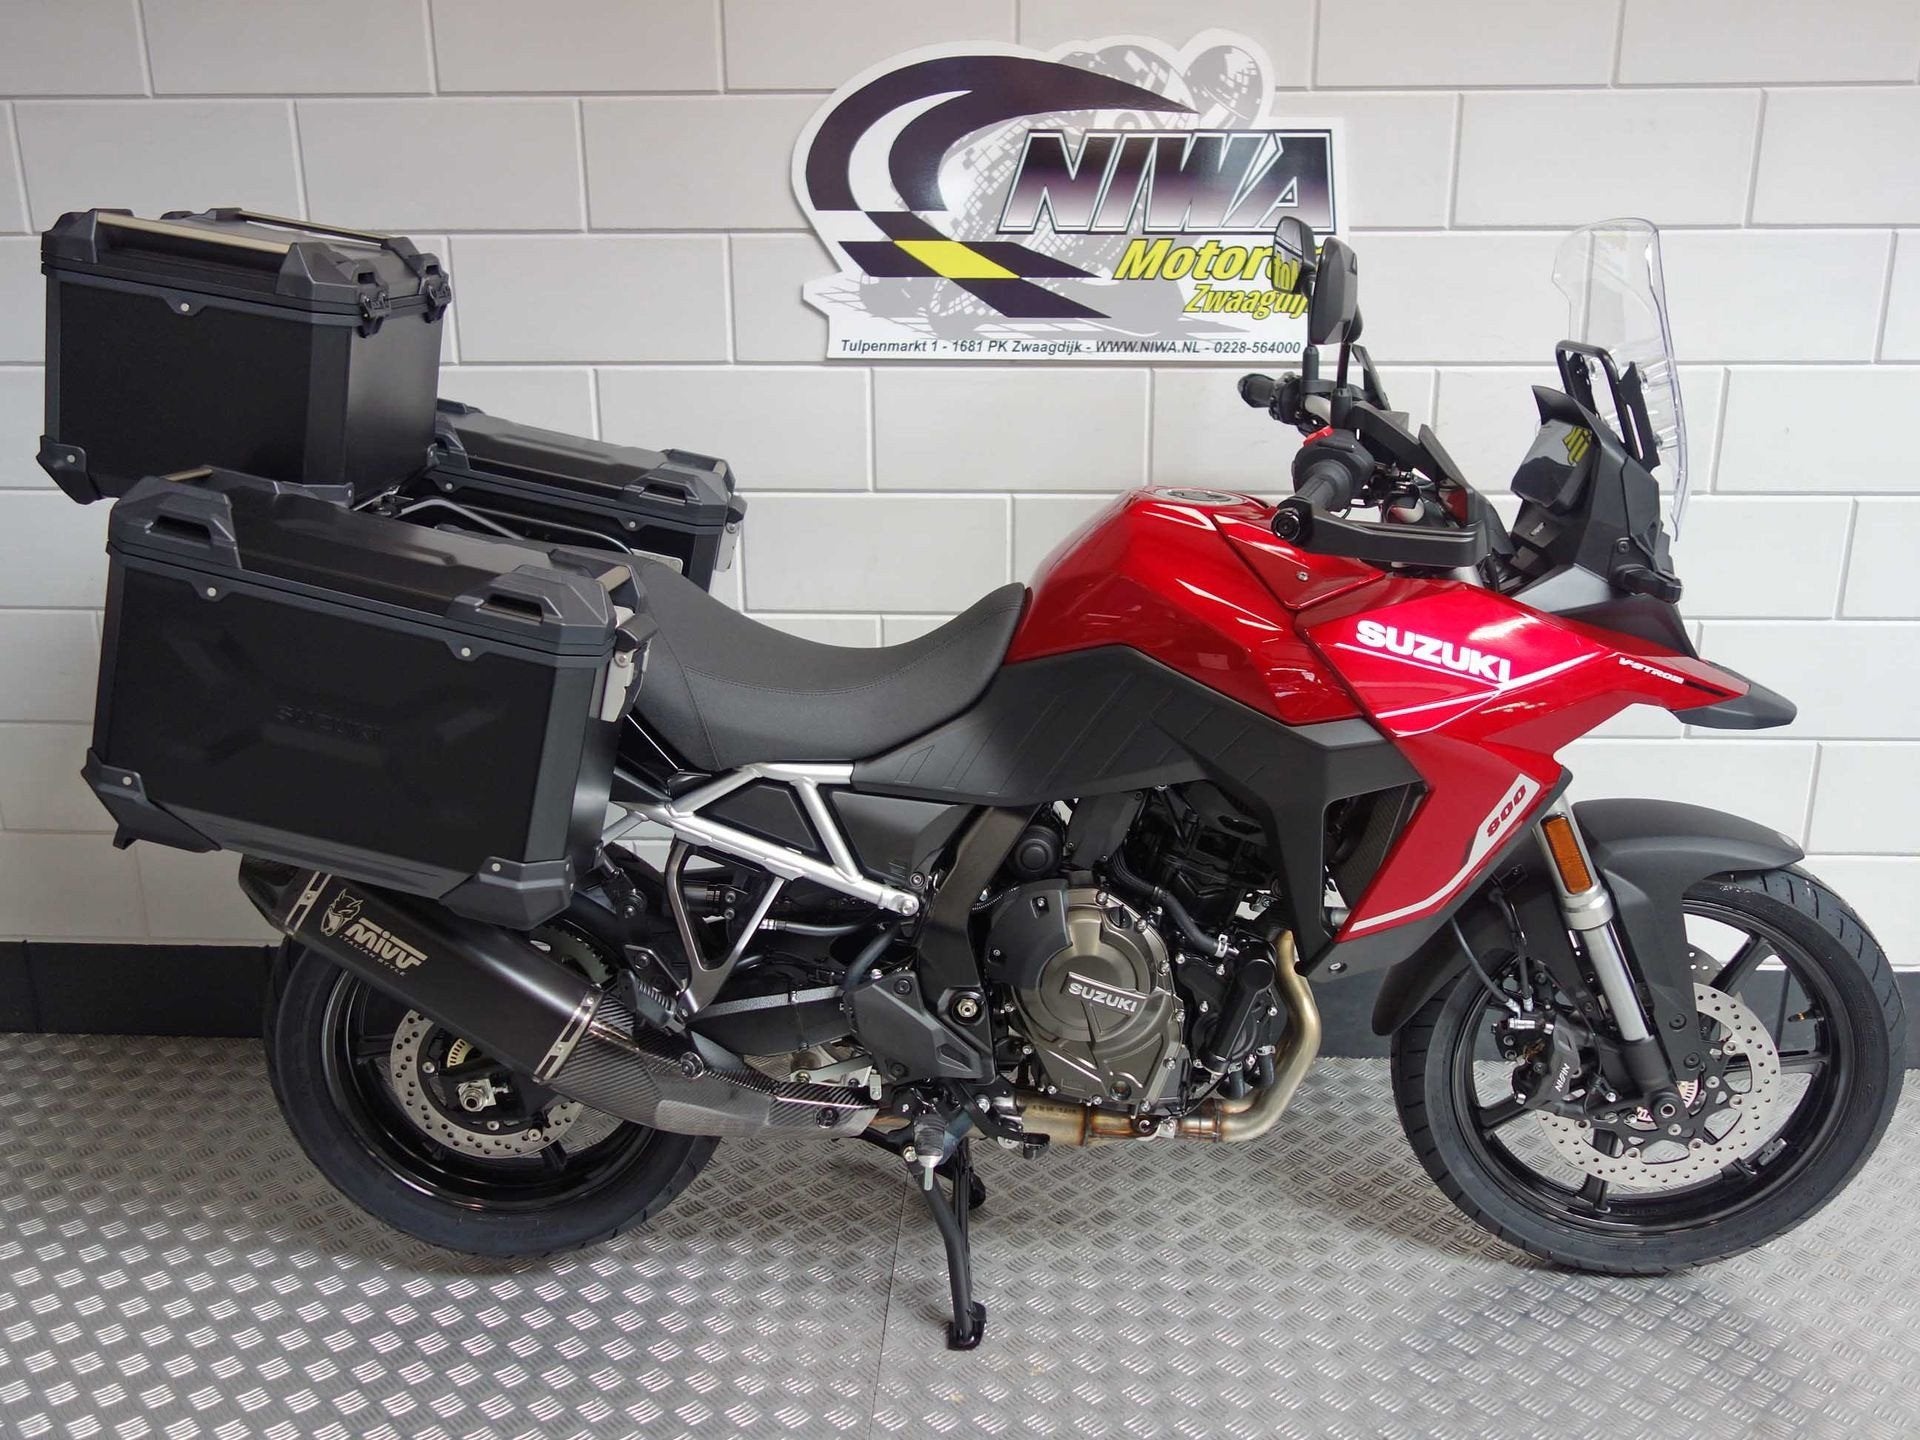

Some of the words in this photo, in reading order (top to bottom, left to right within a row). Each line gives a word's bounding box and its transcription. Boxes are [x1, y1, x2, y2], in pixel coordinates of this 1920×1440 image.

[997, 129, 1337, 236] NIWA
[1112, 238, 1324, 281] Motor
[841, 339, 927, 354] Tulpenmarkt
[931, 340, 938, 352] 1
[952, 340, 983, 352] 1681
[987, 341, 1008, 352] PK
[1012, 340, 1082, 355] Zwaagdijk
[1096, 341, 1200, 353] WWW.NIWA.NL
[1214, 341, 1301, 354] 0228-564000
[1356, 620, 1512, 684] SUZUKI
[1487, 784, 1526, 837] 800
[1068, 981, 1138, 1013] SUZUKI
